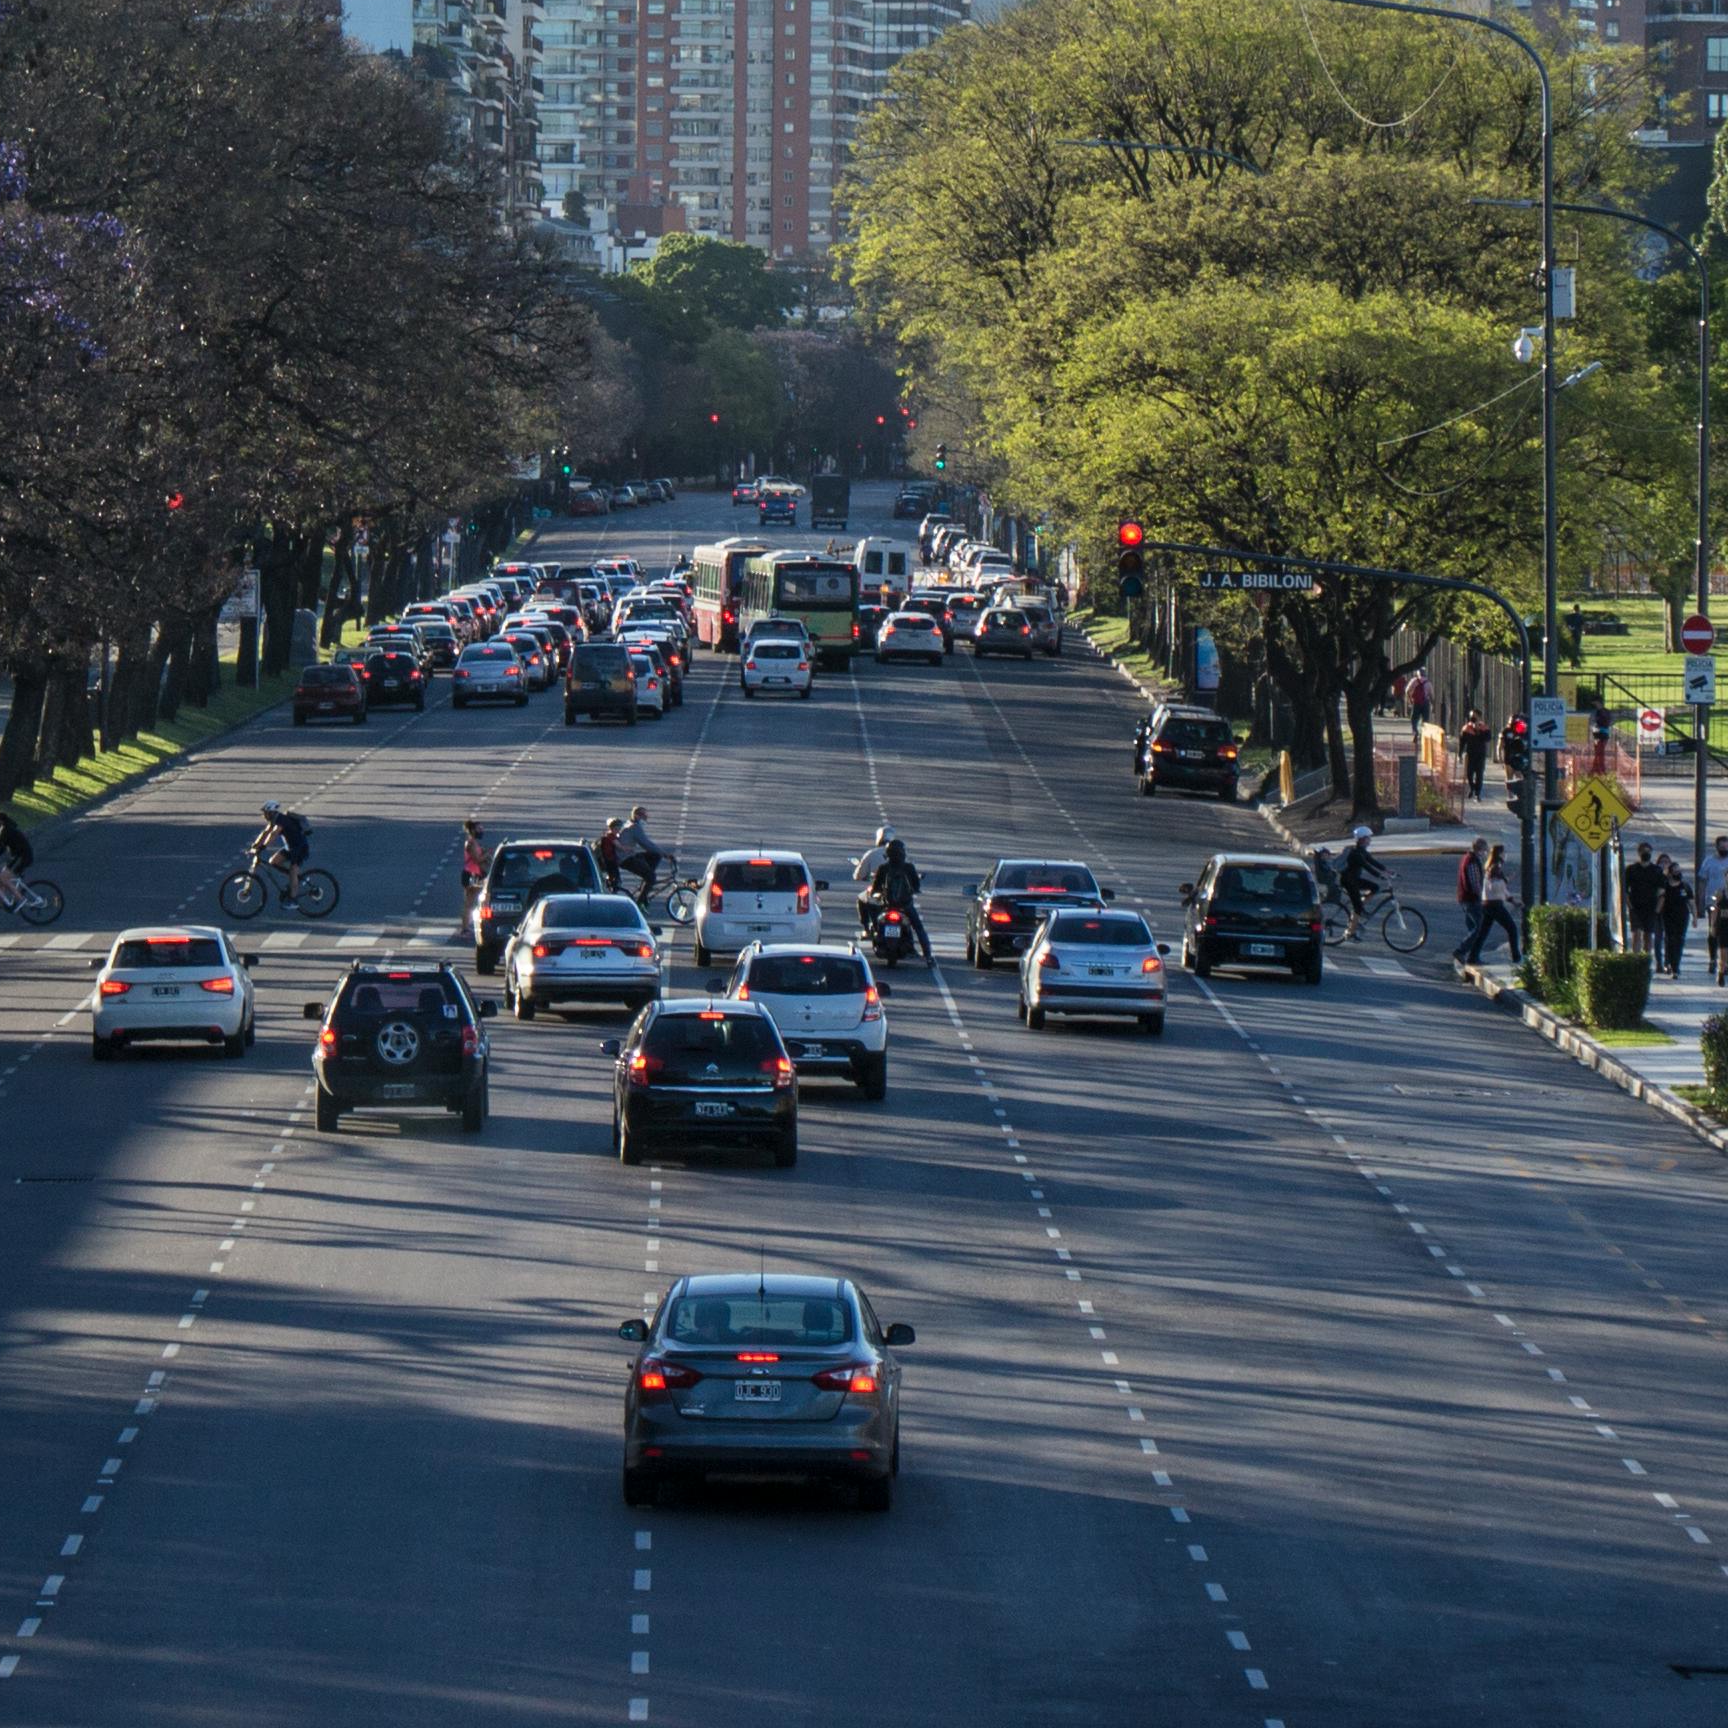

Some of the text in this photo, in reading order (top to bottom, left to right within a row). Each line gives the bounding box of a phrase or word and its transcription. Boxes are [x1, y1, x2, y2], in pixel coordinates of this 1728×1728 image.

[1202, 573, 1312, 588] J. A. BIBILONI
[760, 1385, 779, 1397] 930
